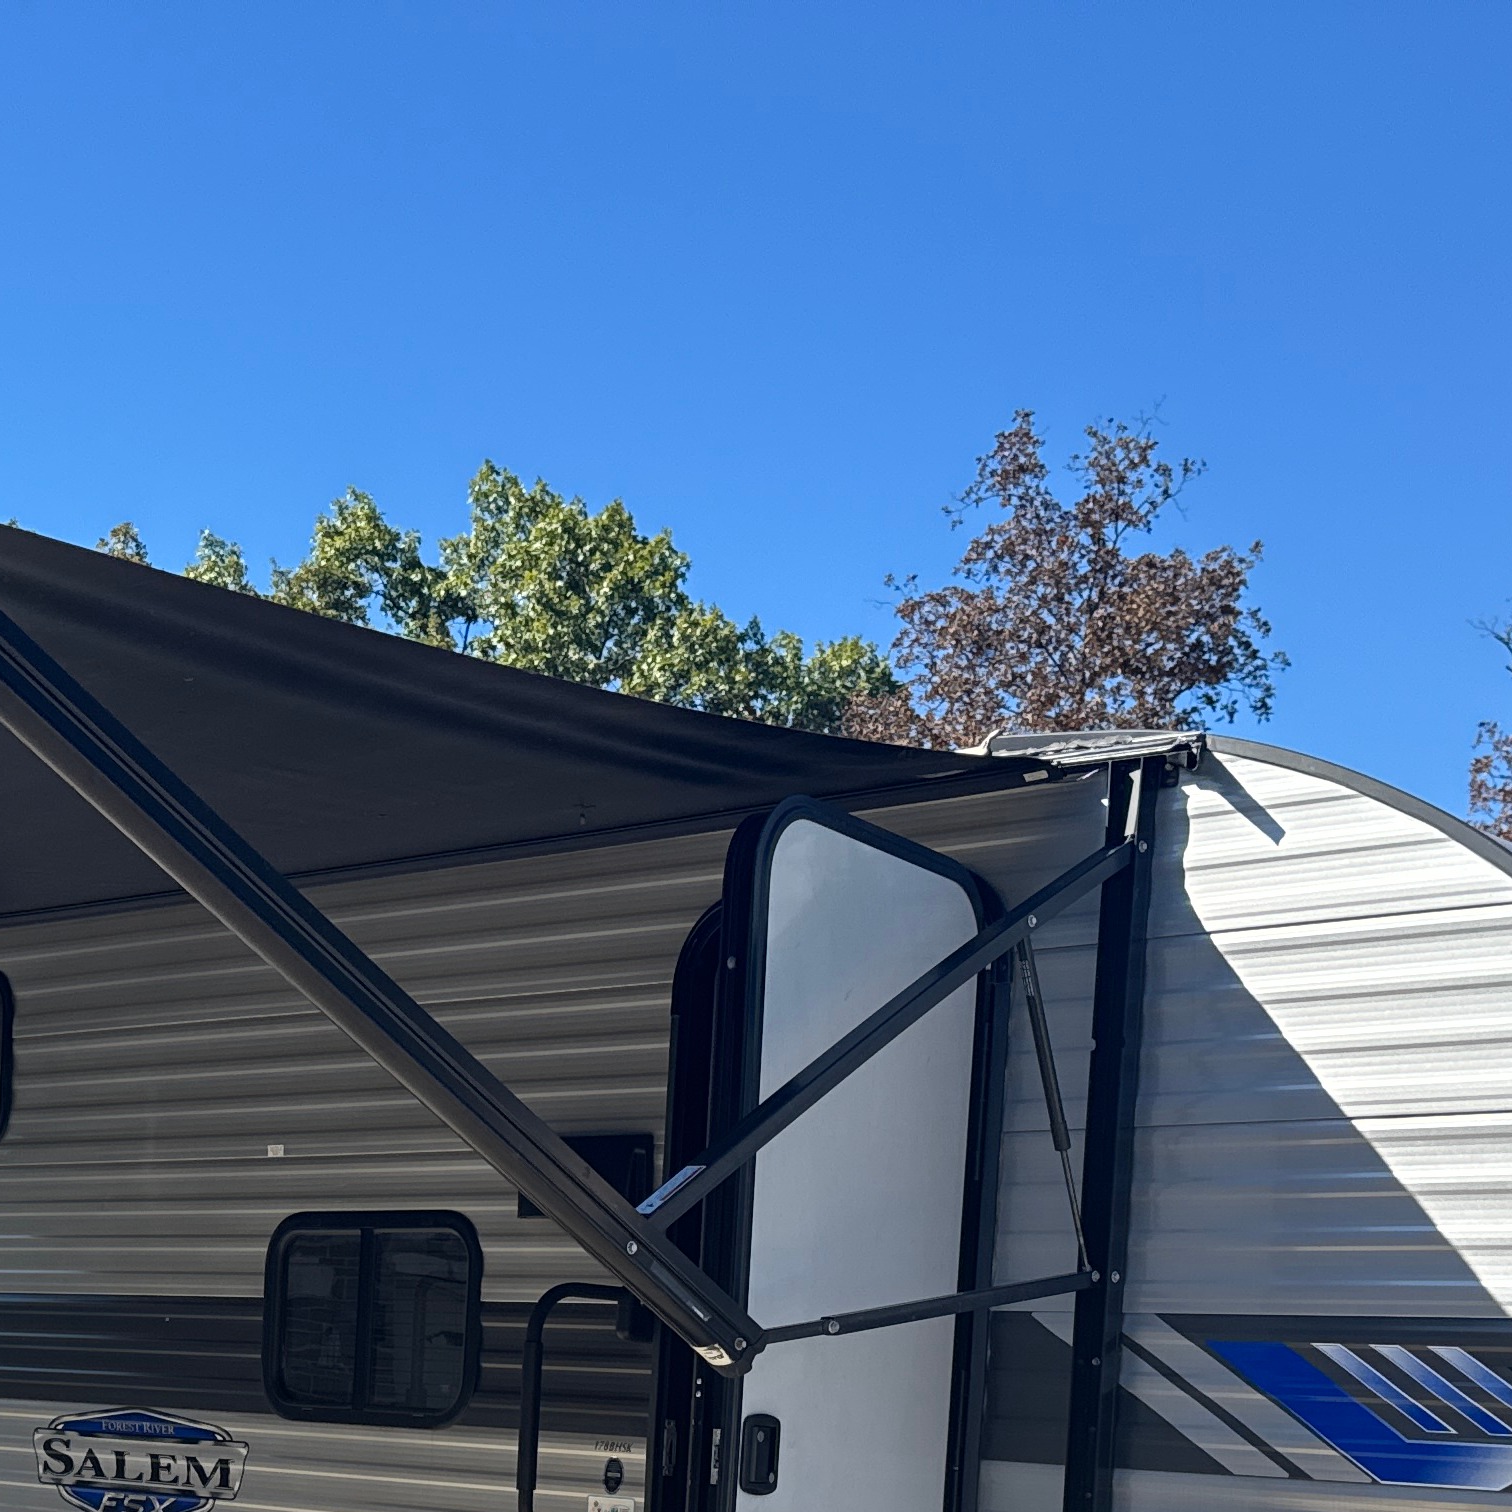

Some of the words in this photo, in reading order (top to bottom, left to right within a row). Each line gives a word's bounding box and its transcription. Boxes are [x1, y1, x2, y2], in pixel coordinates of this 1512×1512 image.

[101, 1419, 142, 1433] FOREST
[142, 1421, 175, 1435] RIVER
[42, 1437, 235, 1491] SALEM
